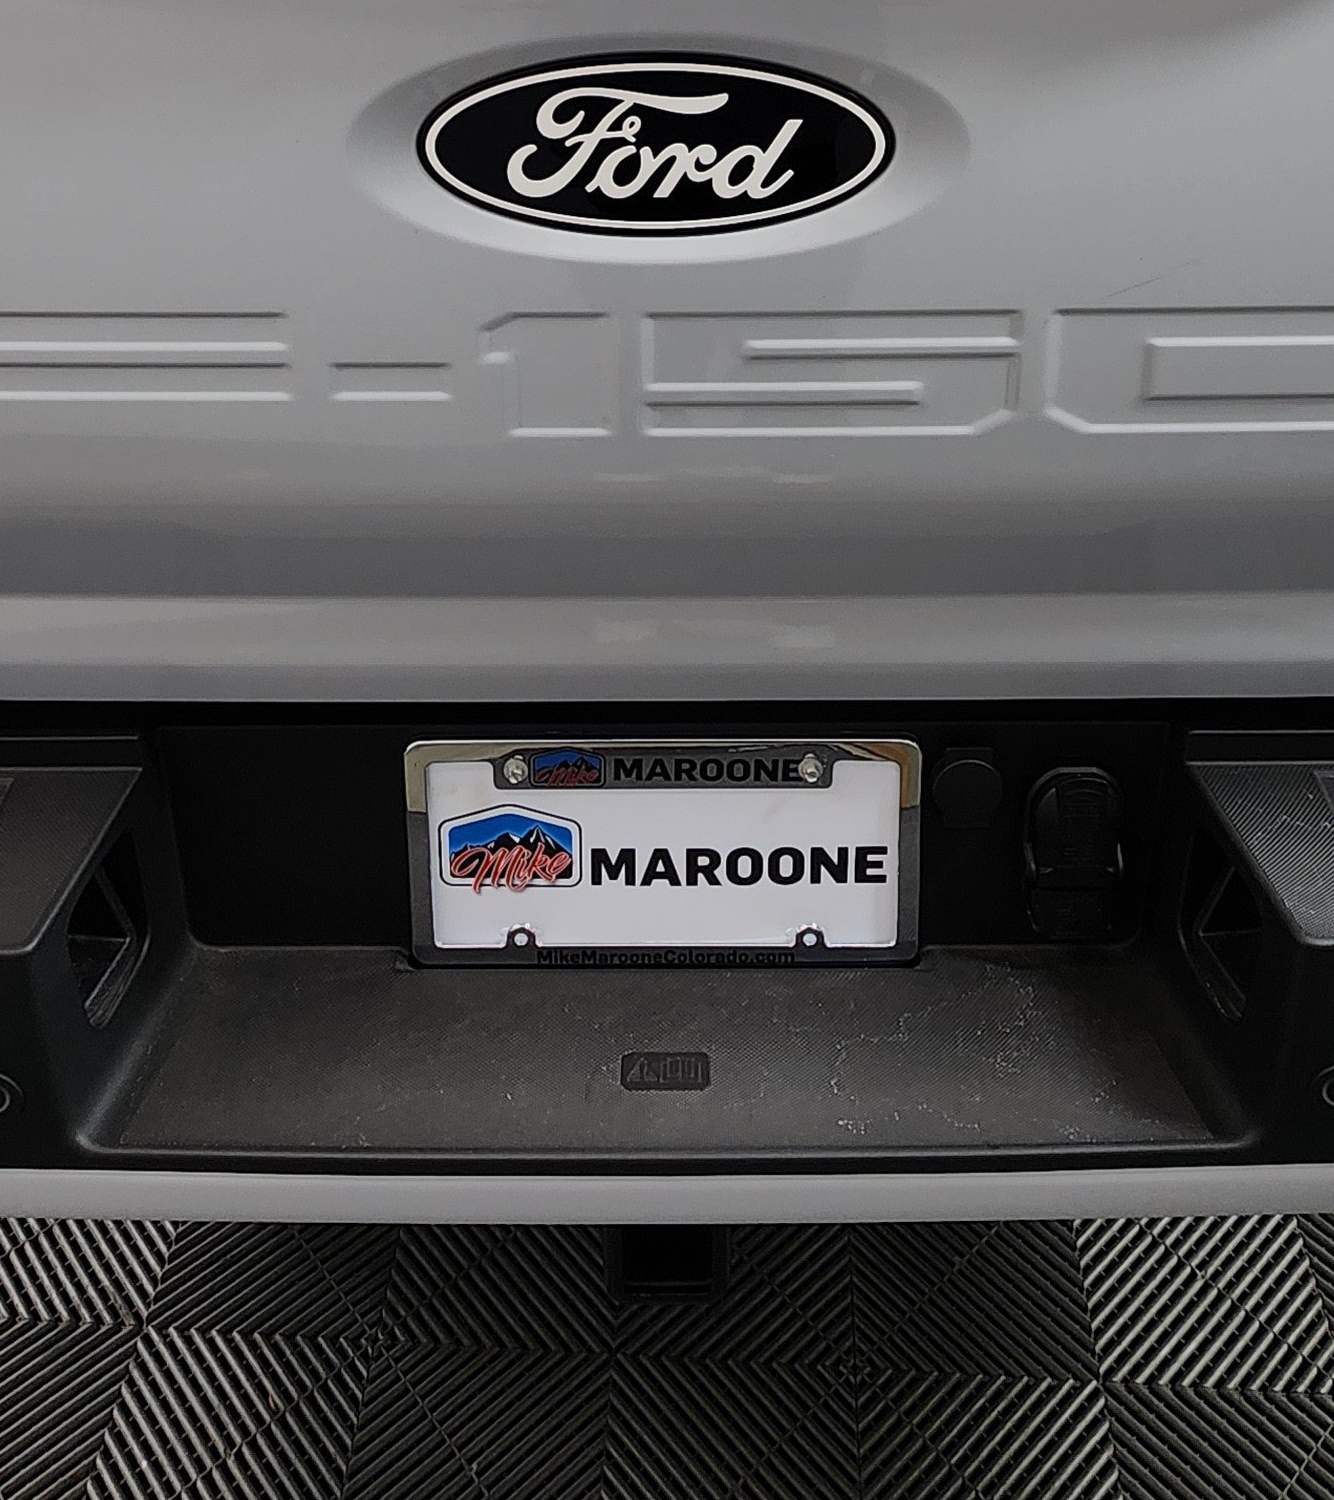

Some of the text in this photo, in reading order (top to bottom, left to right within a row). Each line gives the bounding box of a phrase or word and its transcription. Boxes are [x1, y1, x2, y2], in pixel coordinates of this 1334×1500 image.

[507, 87, 804, 198] Ford
[535, 758, 805, 787] Mike MAROONE
[451, 841, 888, 893] Mike MAROONE
[536, 950, 795, 965] MikeMarooneColorado.com
